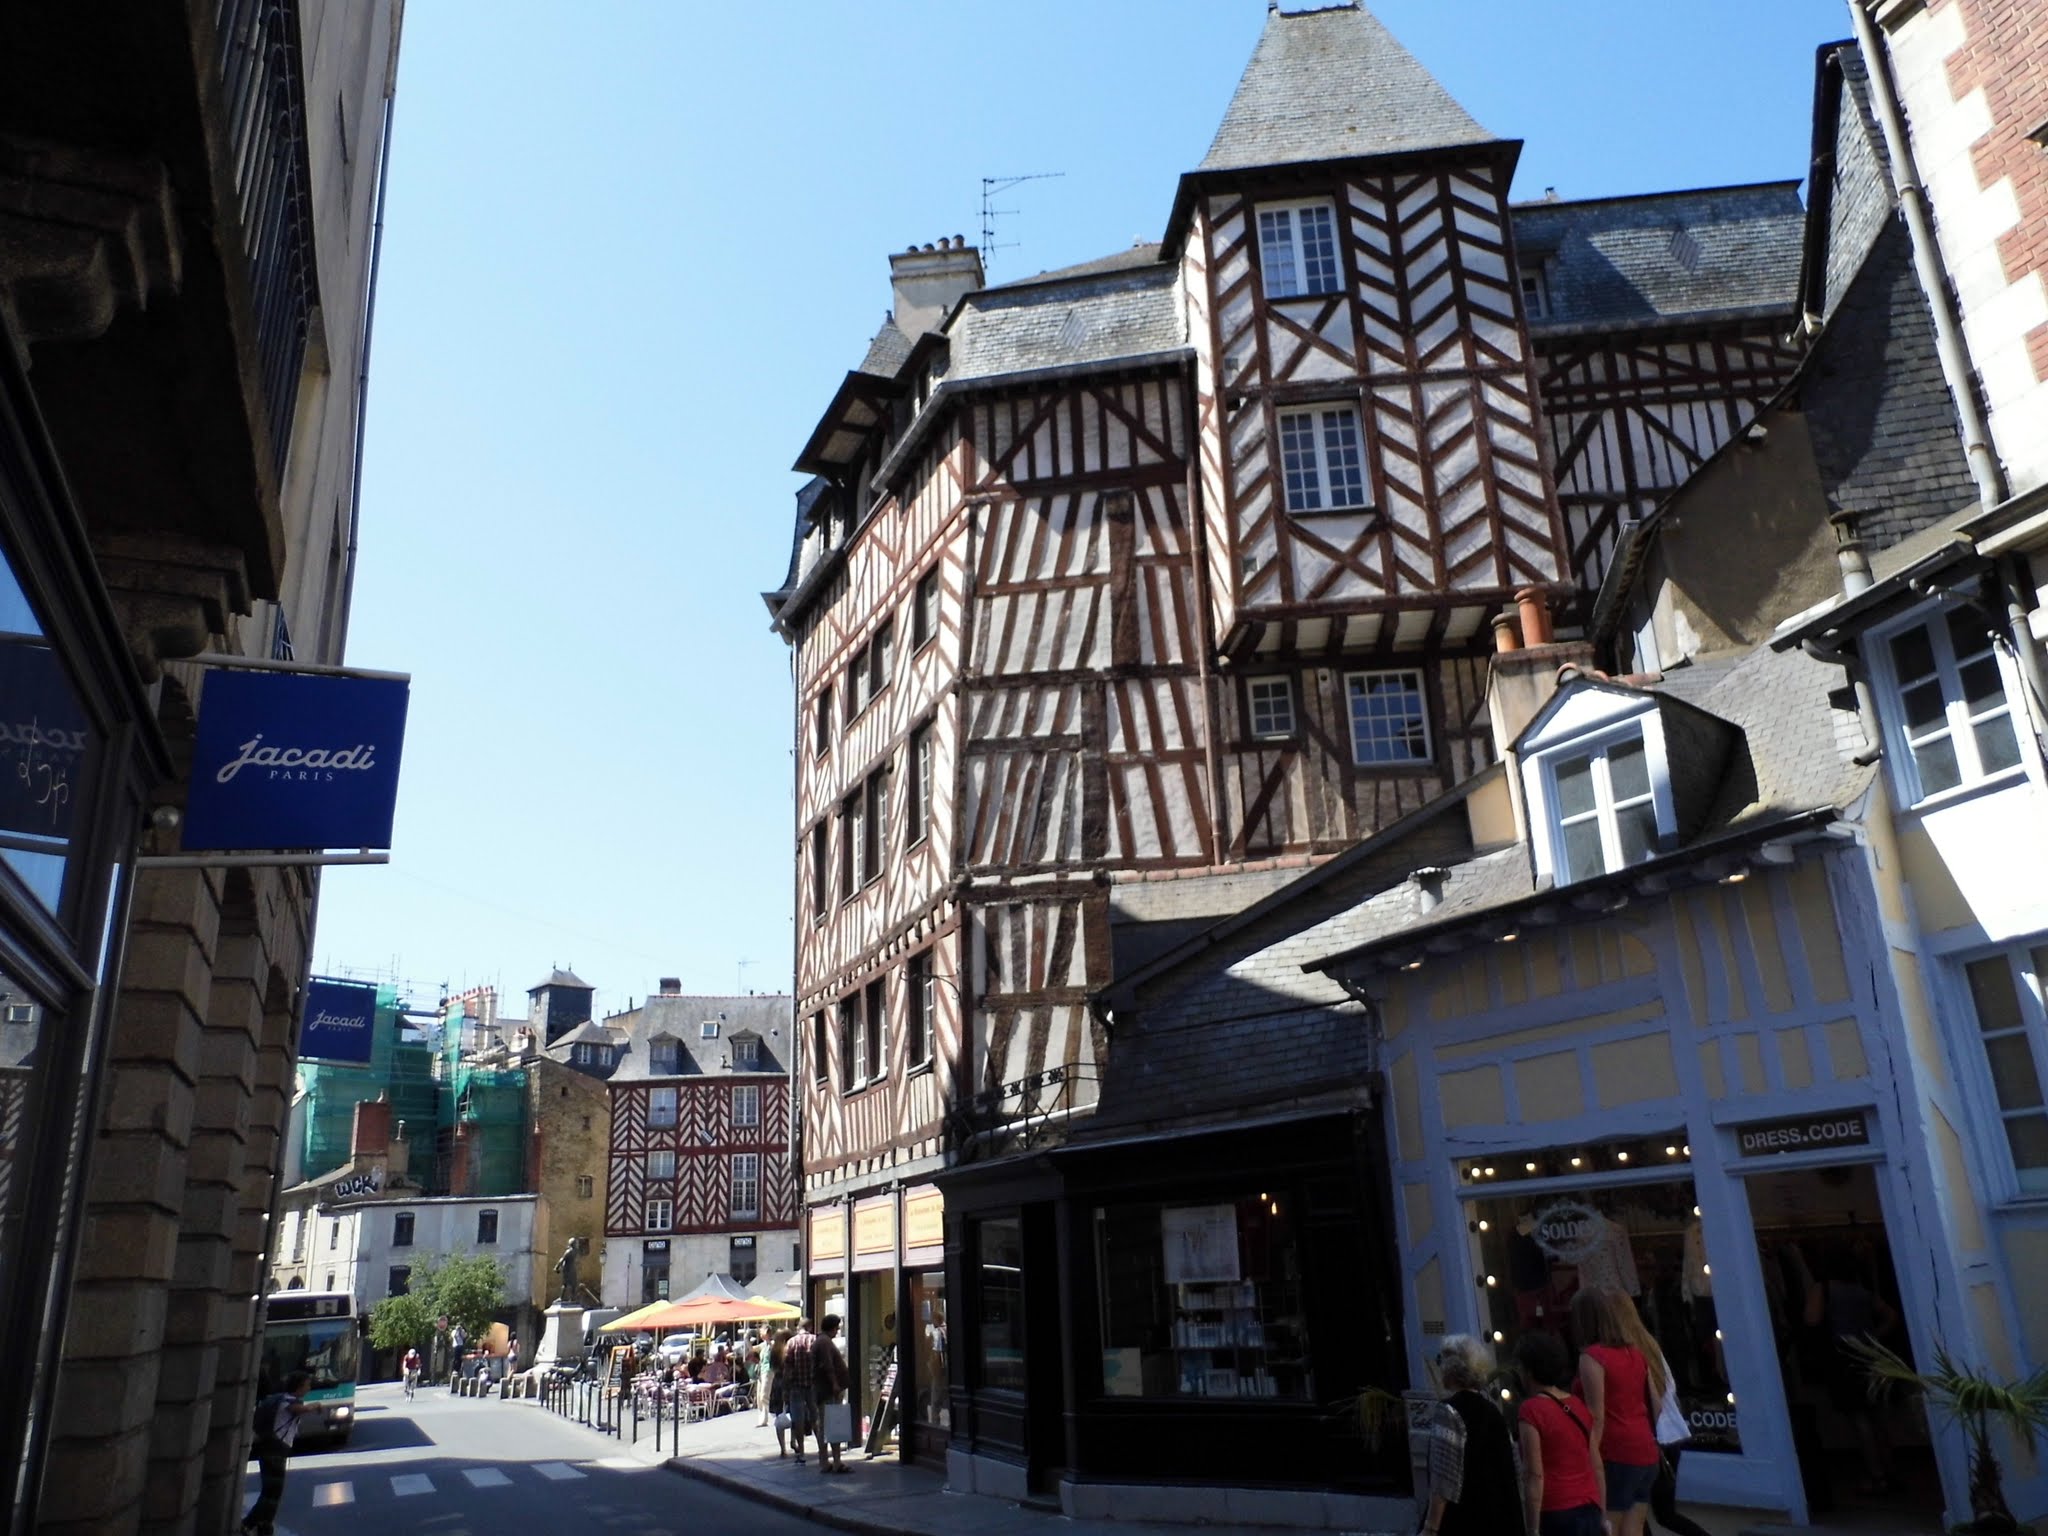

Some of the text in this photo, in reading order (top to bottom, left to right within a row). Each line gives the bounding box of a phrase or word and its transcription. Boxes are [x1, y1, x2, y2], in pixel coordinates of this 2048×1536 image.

[216, 732, 376, 784] jacadi
[269, 770, 335, 782] PARIS
[309, 1008, 366, 1031] jacadi
[1743, 1118, 1863, 1150] DRESS.CODE
